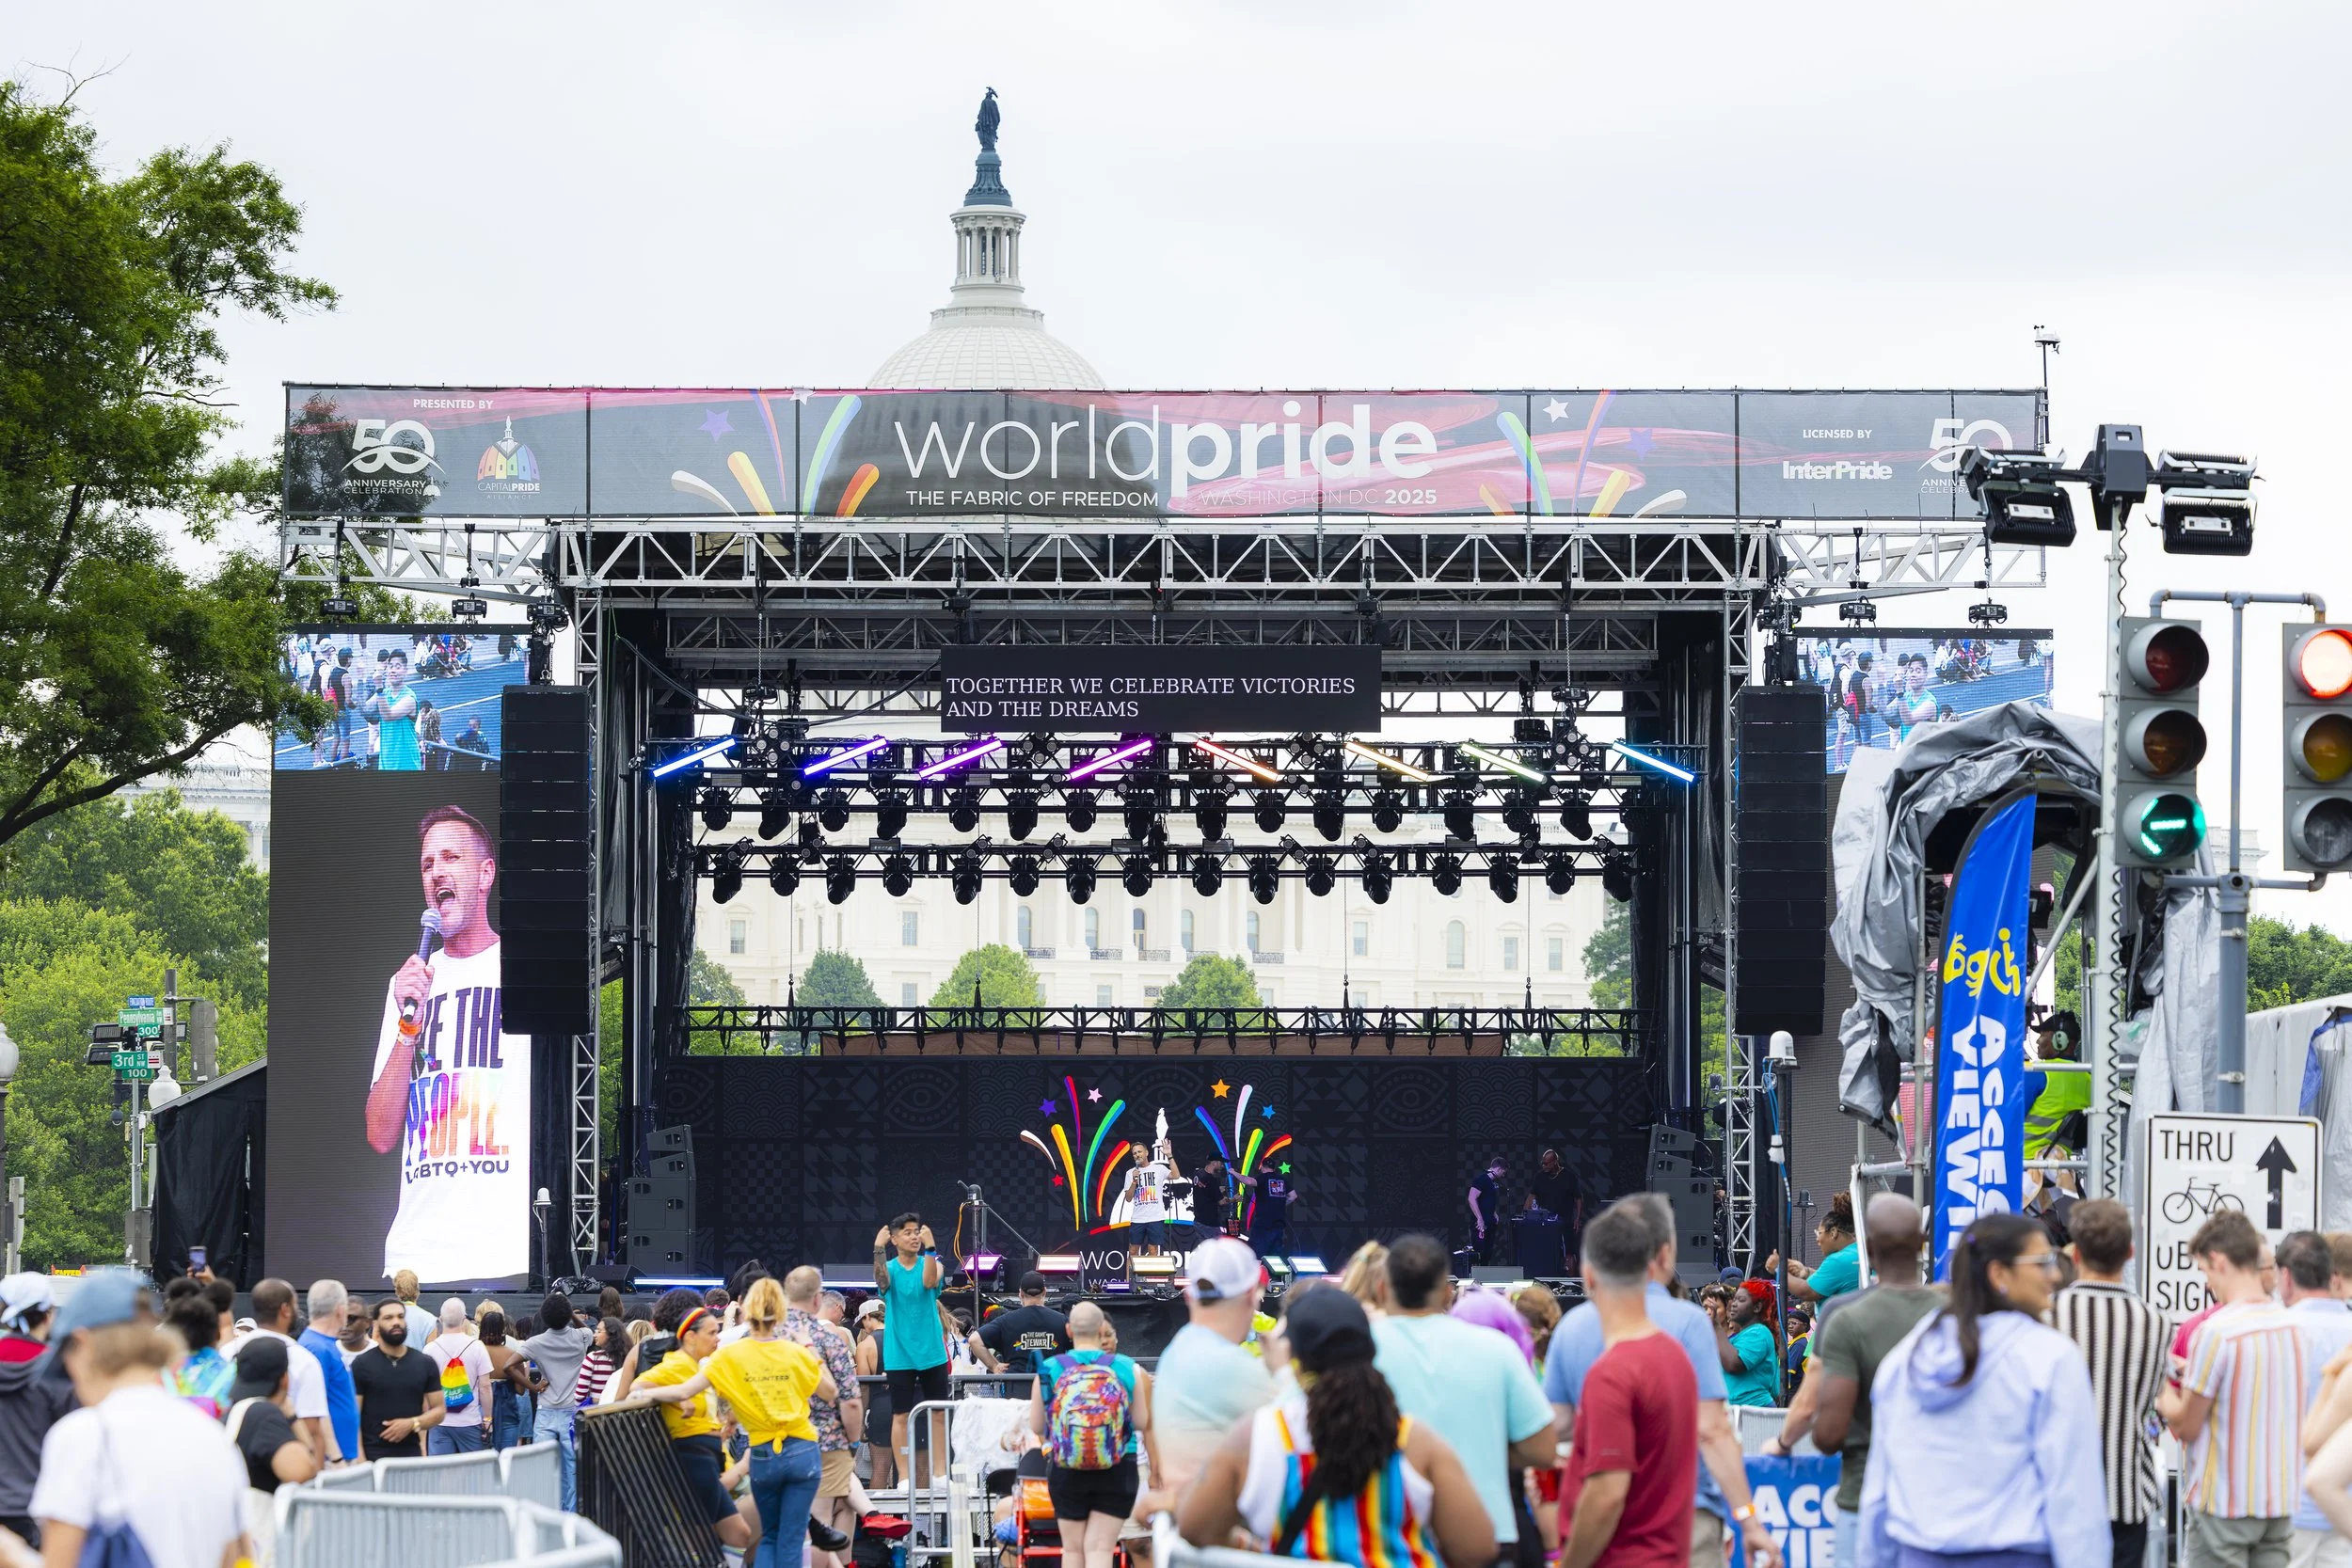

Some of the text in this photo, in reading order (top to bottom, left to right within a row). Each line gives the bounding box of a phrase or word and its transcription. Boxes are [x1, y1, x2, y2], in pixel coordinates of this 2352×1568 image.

[413, 399, 494, 409] PRESENTED BY
[1803, 429, 1873, 439] LICENSED BY
[352, 419, 436, 474] 50
[895, 401, 1438, 497] worldpride
[1783, 460, 1893, 480] InterPride
[343, 486, 422, 495] CELEBRATION
[344, 479, 427, 488] ANNIVERSARY
[1922, 479, 1966, 487] ANNIVE
[906, 490, 1159, 507] THE FABRIC OF FREEDOM
[1200, 489, 1438, 505] WASHINGTON DC 2025
[946, 677, 1356, 694] TOGETHER WE CELEBRATE VICTORIES
[946, 701, 1139, 718] AND THE DREAMS
[138, 1026, 158, 1036] 300
[114, 1054, 135, 1068] 3rd
[127, 1069, 148, 1078] 100
[1977, 1014, 2010, 1220] ACCES
[1946, 1014, 1980, 1251] VIEWI
[2159, 1130, 2233, 1163] THRU
[1021, 1333, 1054, 1350] STEWARD
[1753, 1483, 1841, 1528] ACC
